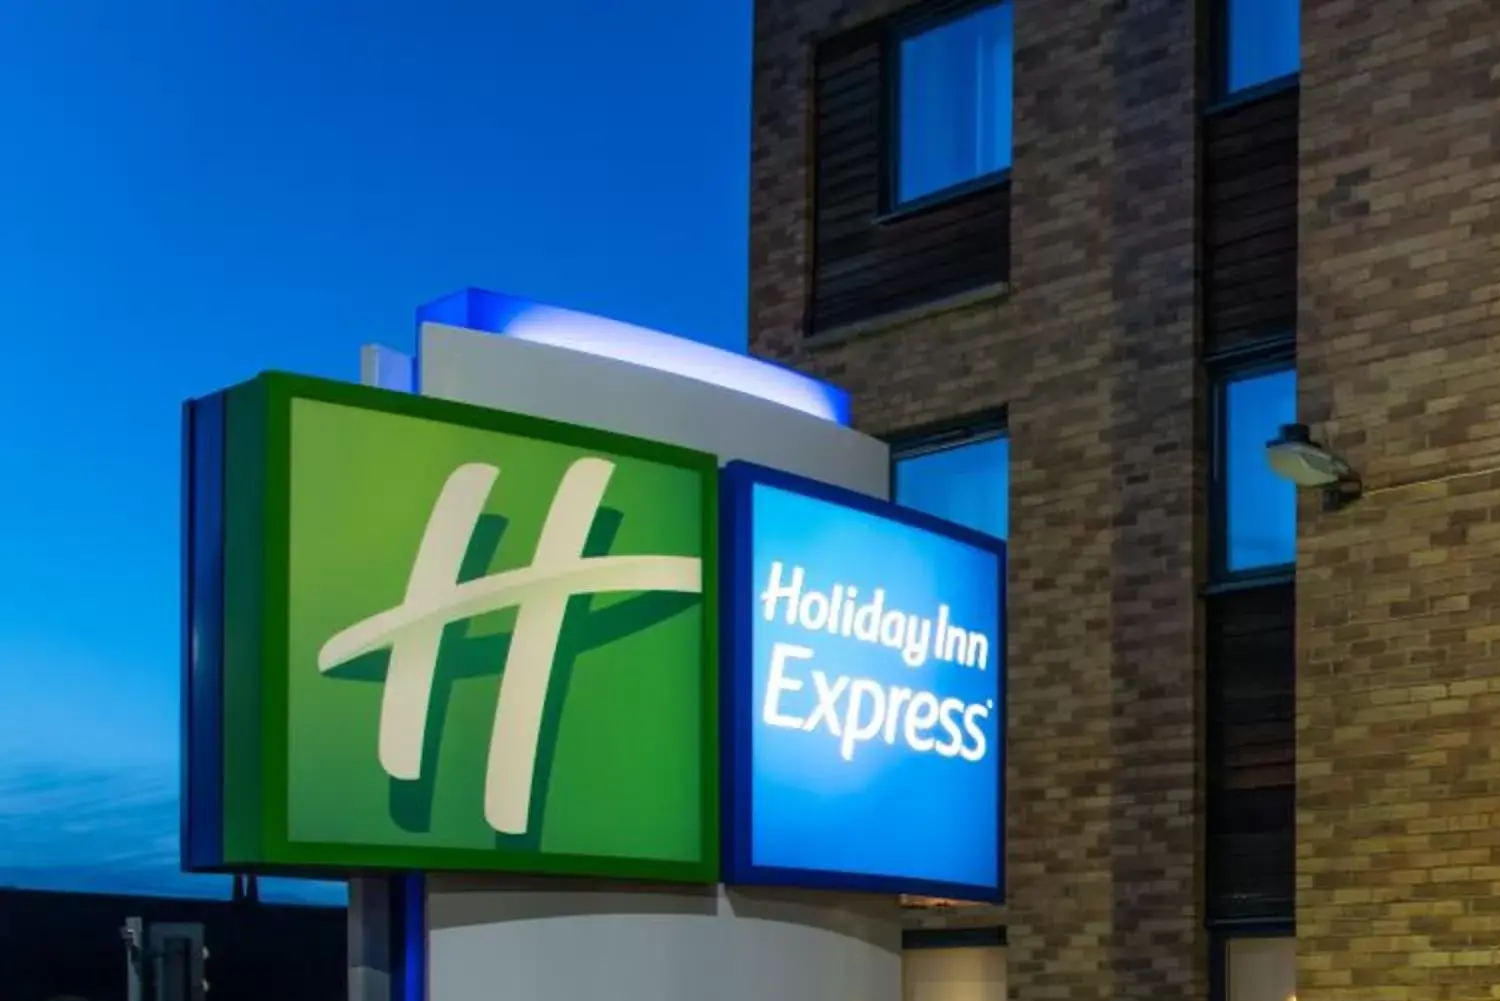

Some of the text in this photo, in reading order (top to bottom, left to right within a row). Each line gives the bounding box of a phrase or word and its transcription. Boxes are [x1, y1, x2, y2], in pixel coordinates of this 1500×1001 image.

[318, 457, 702, 834] H
[761, 561, 989, 670] Holiday Inn
[763, 642, 989, 761] Express
